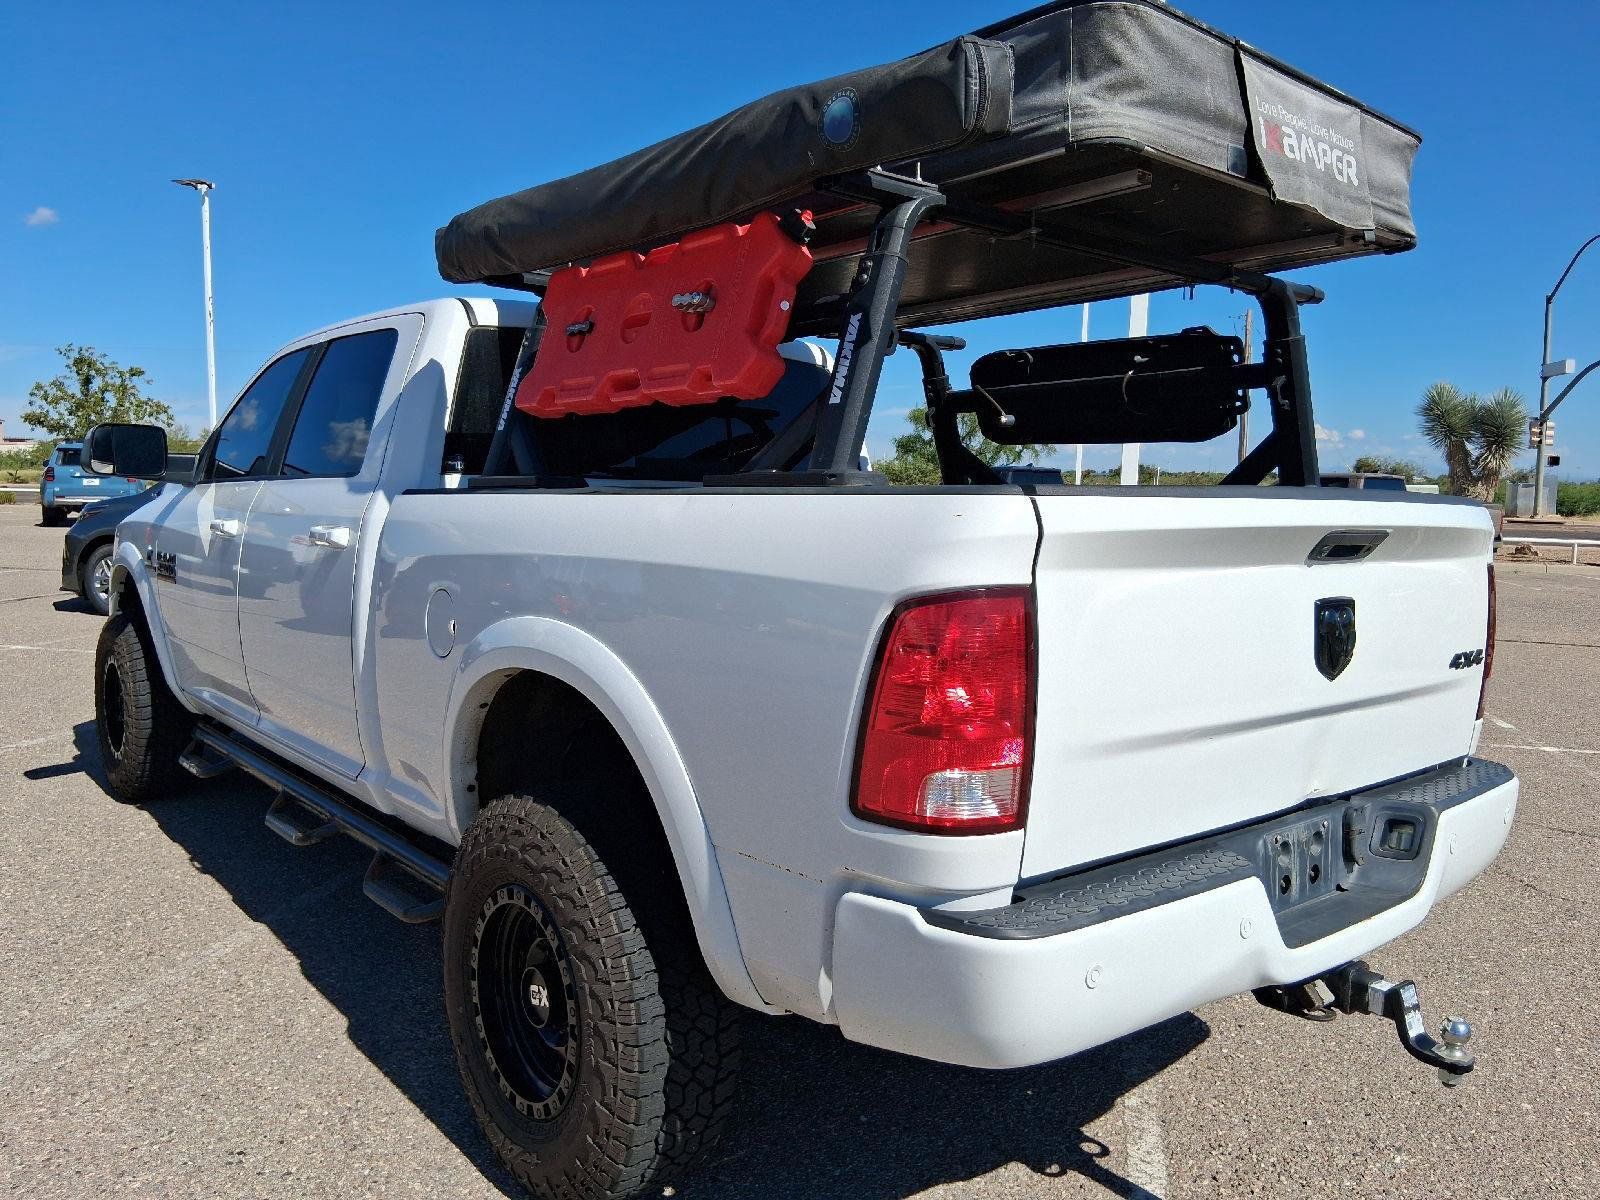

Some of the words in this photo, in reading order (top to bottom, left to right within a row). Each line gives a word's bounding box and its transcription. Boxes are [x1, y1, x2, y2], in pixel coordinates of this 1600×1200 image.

[1256, 95, 1278, 117] Love
[1311, 124, 1329, 140] Love
[1329, 125, 1354, 151] Nature
[828, 312, 863, 405] YAKIMA
[497, 367, 522, 431] YAKIMA
